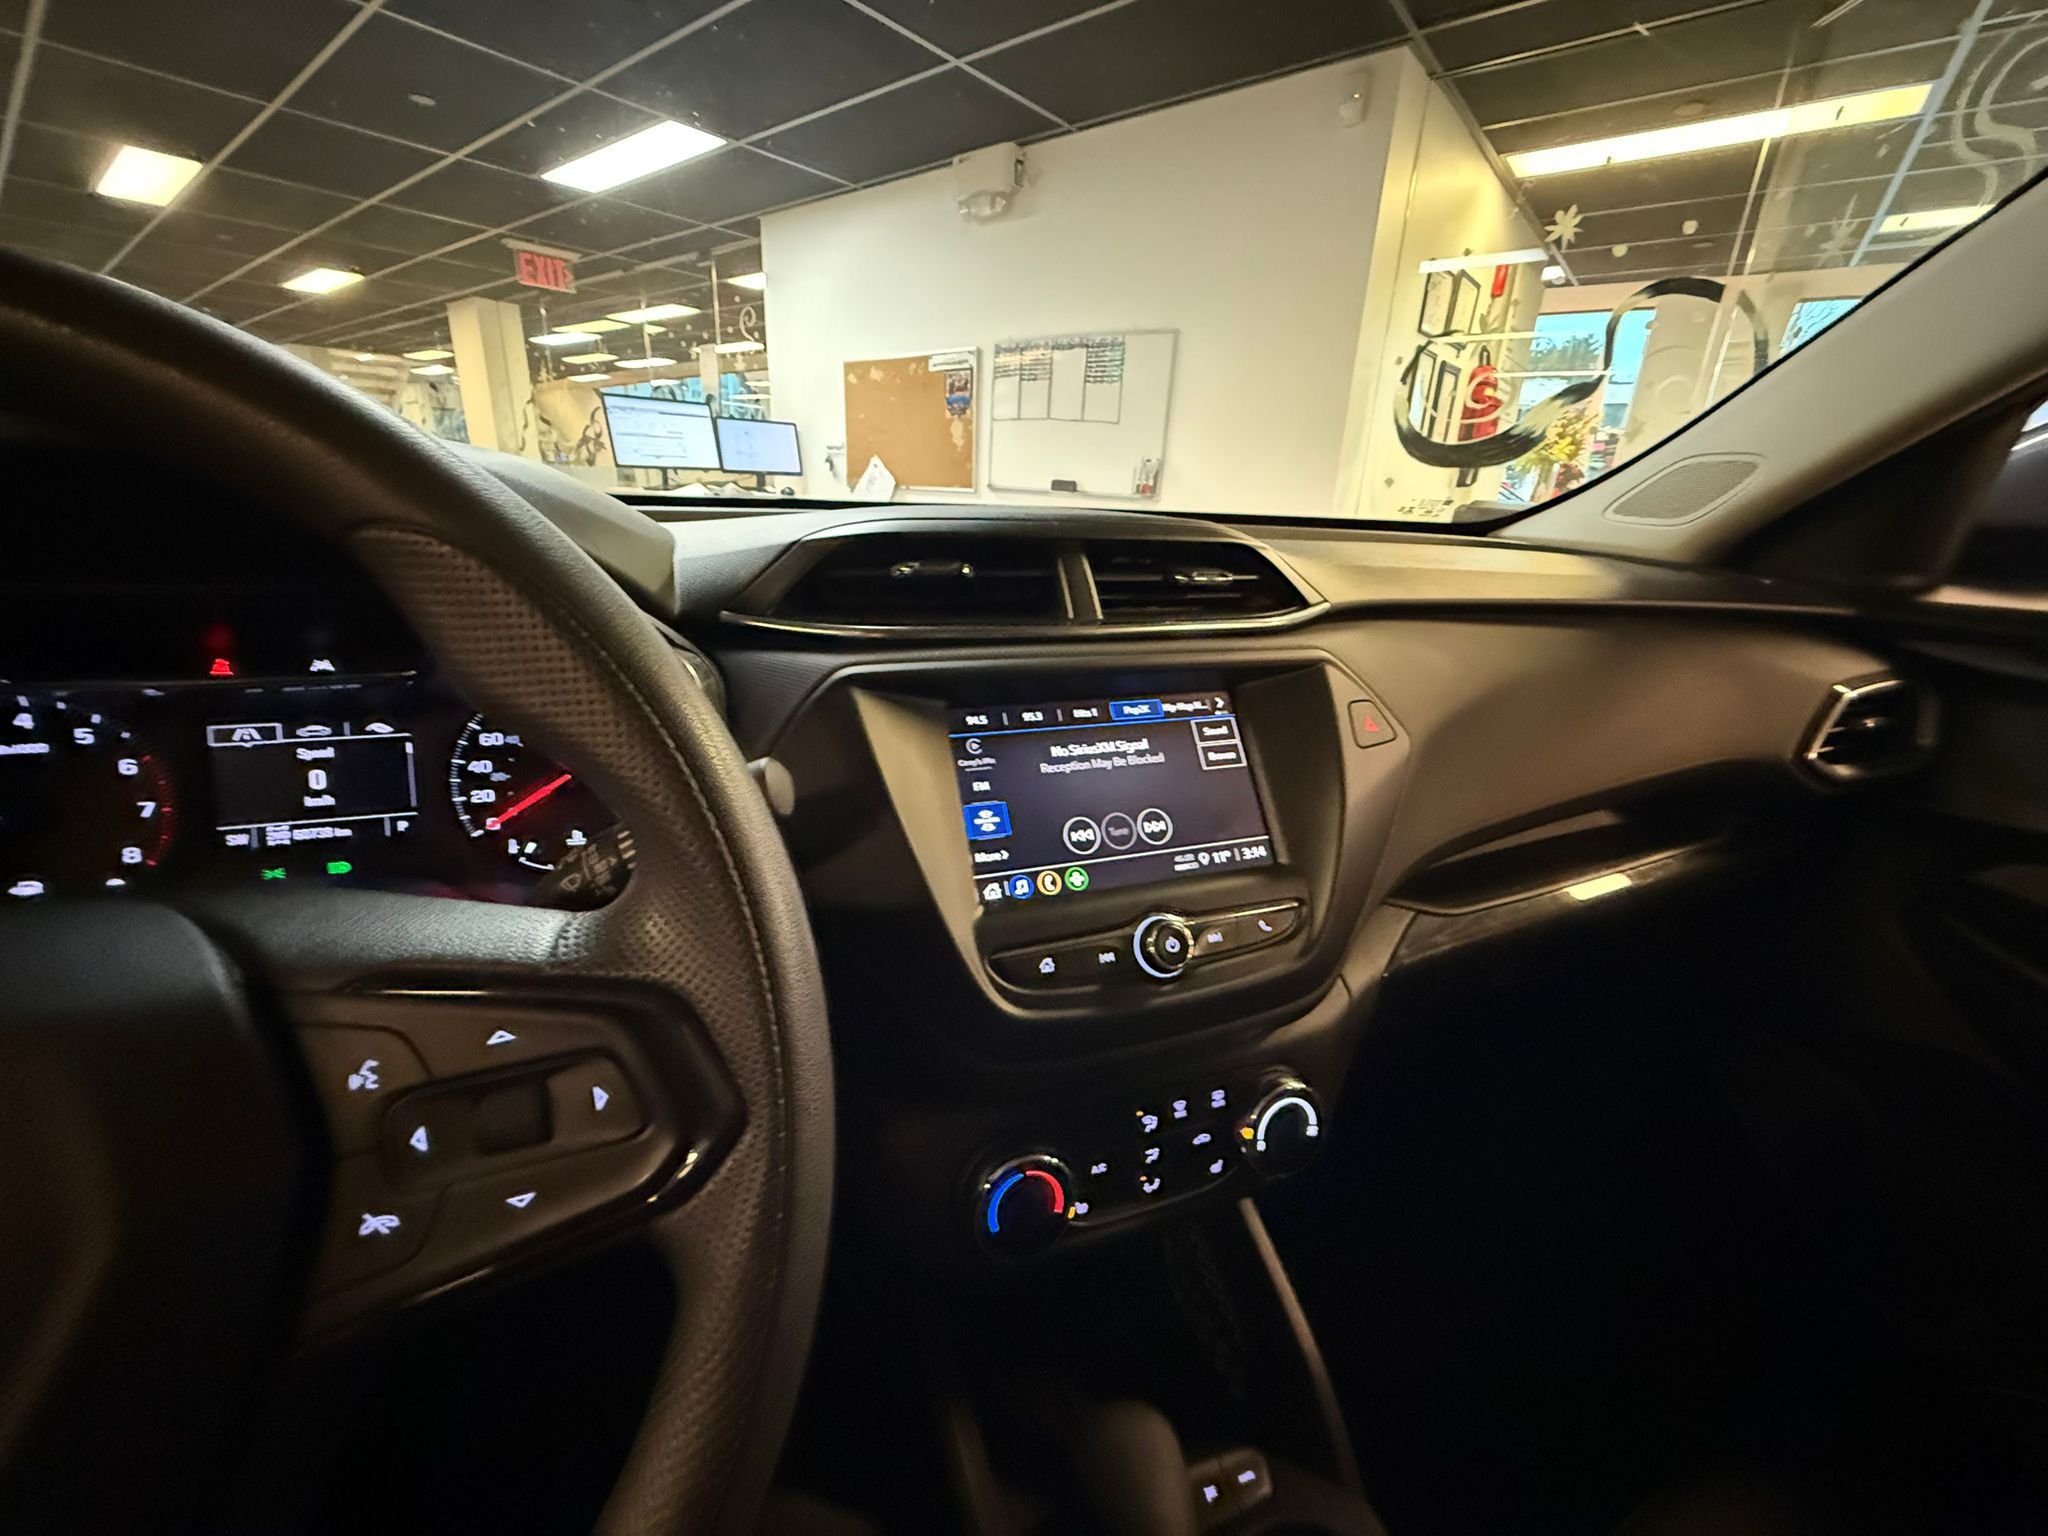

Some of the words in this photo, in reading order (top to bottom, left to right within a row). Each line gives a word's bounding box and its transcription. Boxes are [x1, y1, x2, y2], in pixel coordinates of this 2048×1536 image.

[518, 251, 567, 289] EXIT
[73, 727, 96, 745] 5
[479, 732, 505, 747] 60
[1050, 745, 1069, 758] No
[1115, 737, 1150, 754] Signal
[117, 758, 140, 776] 6
[467, 760, 494, 774] 40
[1039, 760, 1093, 774] Reception
[1091, 757, 1113, 770] May
[1112, 755, 1128, 767] Be
[1126, 751, 1166, 766] Blocked
[308, 769, 328, 790] 0
[972, 781, 991, 792] FM
[470, 789, 496, 803] 20
[136, 801, 157, 818] 7
[121, 846, 143, 864] 8
